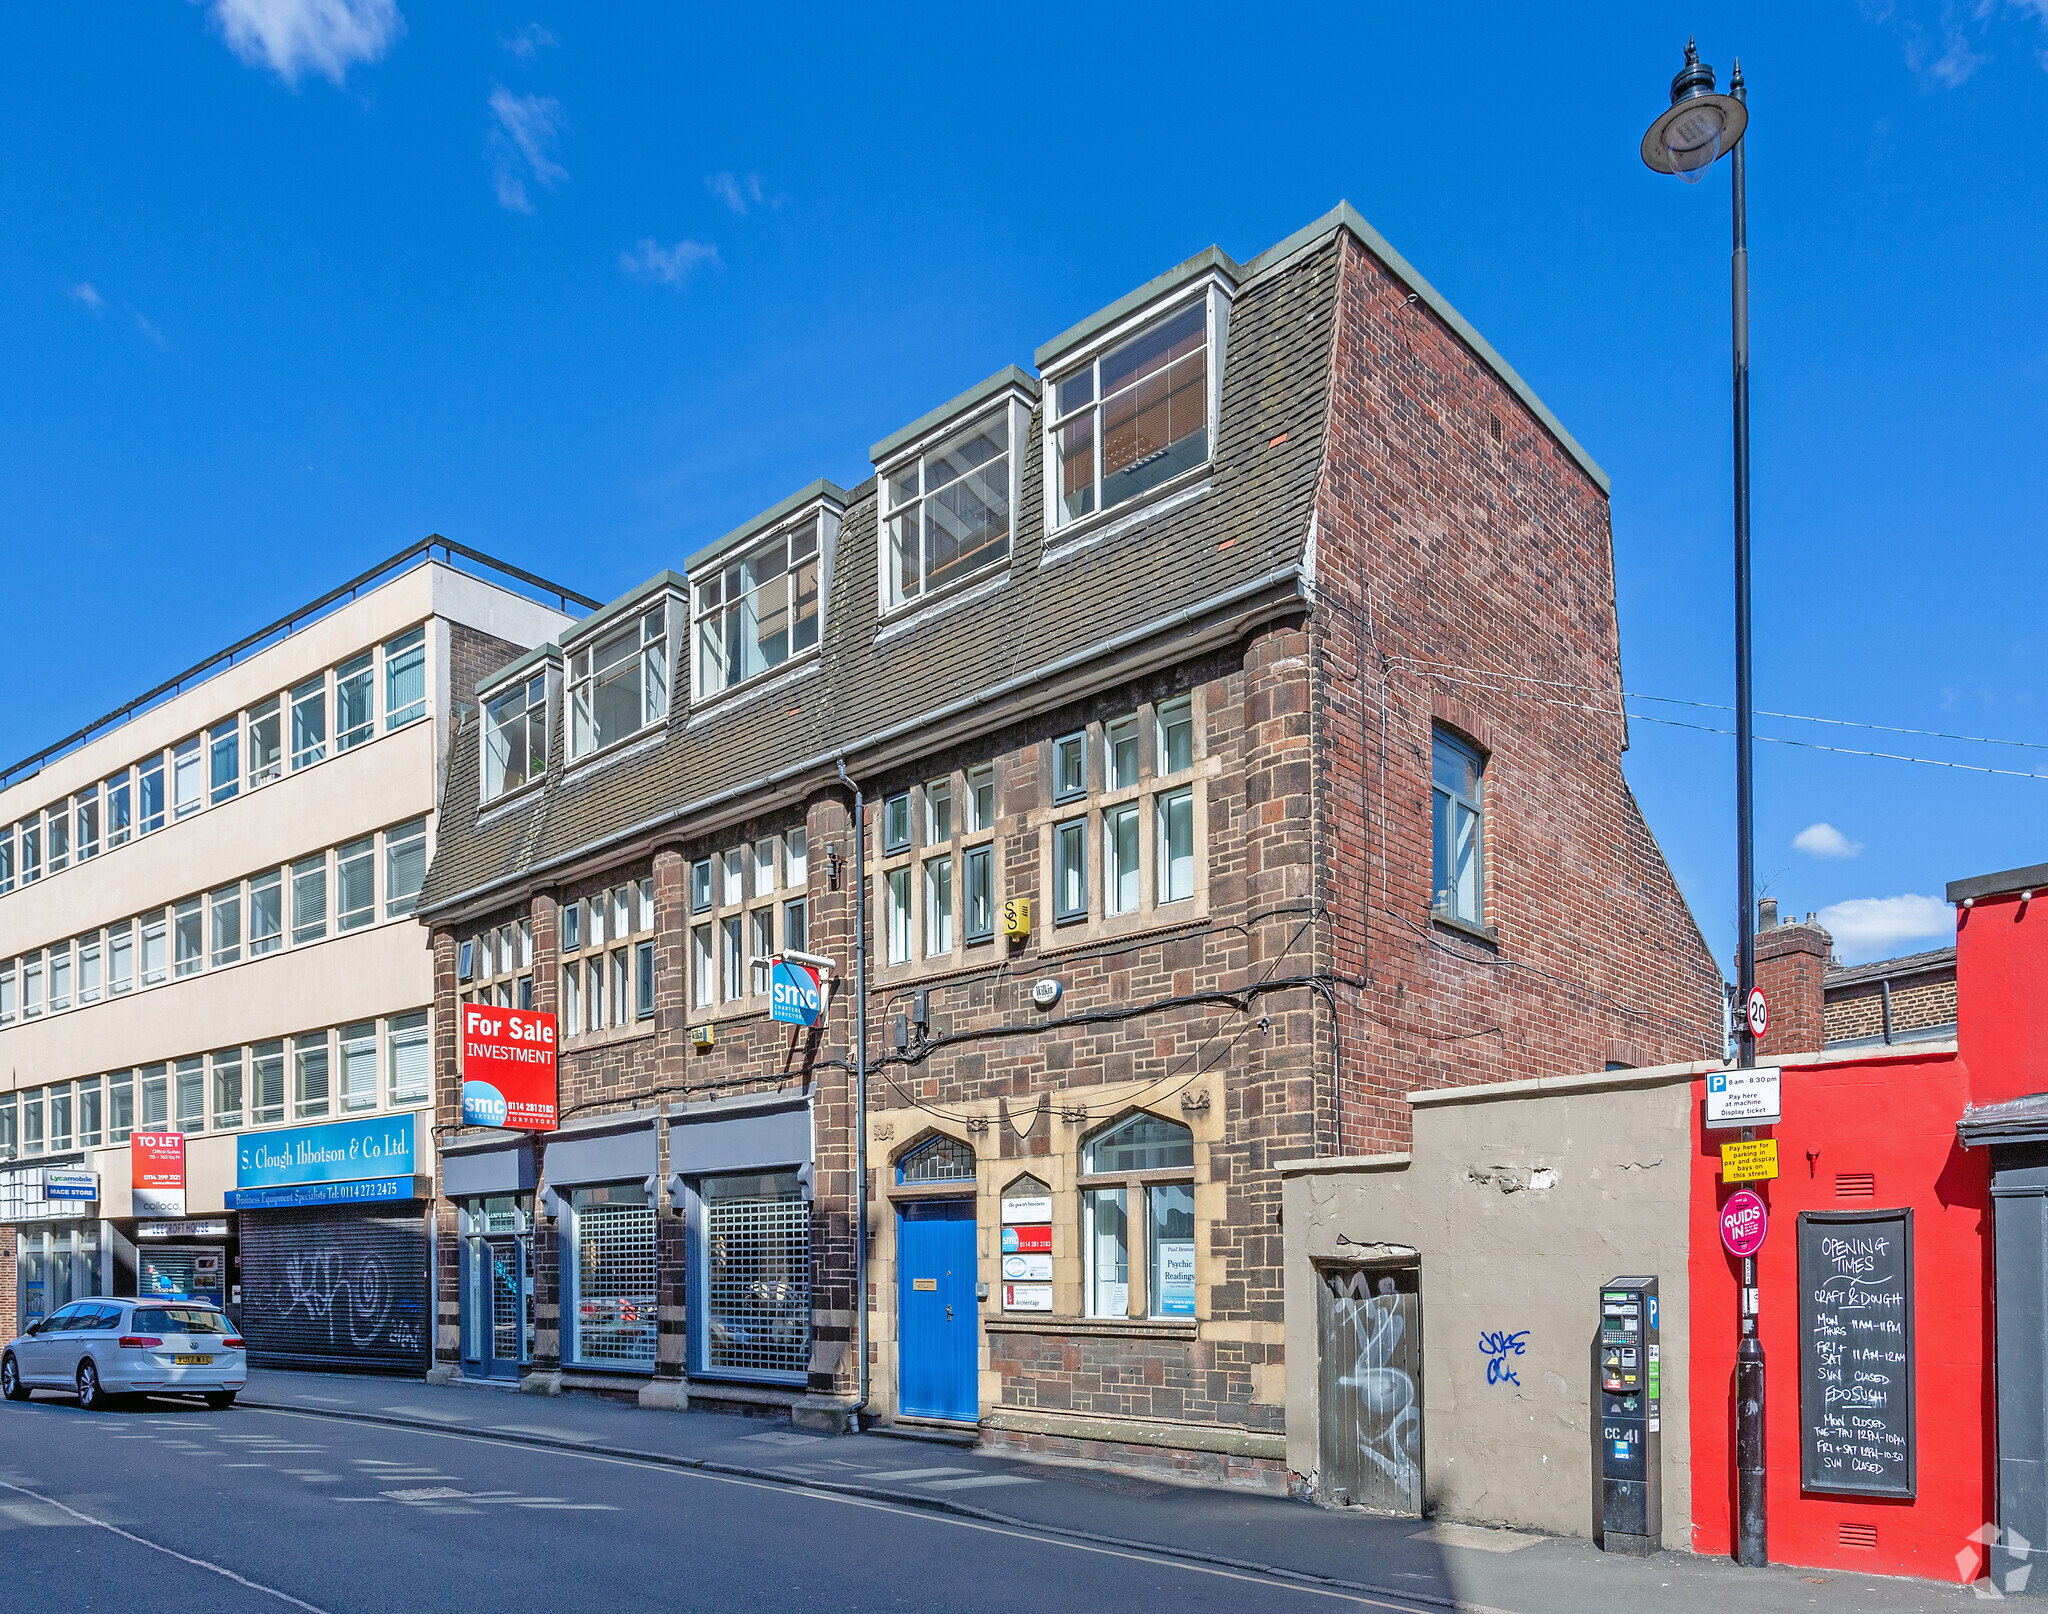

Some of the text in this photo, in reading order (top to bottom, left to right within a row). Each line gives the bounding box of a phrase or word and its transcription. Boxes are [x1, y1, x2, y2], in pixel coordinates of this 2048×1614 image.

[774, 983, 817, 1009] smc
[1752, 1001, 1766, 1024] 20
[467, 1012, 553, 1043] For Sale
[467, 1042, 553, 1064] INVESTMENT
[1713, 1077, 1724, 1091] P
[465, 1097, 504, 1114] smc
[508, 1101, 524, 1111] 0114
[526, 1103, 537, 1112] 281
[465, 1113, 556, 1125] CHARTERED SURVEYORS
[138, 1136, 180, 1147] TO LET
[242, 1129, 409, 1171] S. Clough Ibbotson & Co Ltd.
[236, 1182, 397, 1205] Business Equipment Specialists Tel: 0114 272 2475
[1725, 1206, 1760, 1228] QUIDS
[153, 1222, 209, 1234] LEECROFT HOUSE
[1732, 1224, 1744, 1240] IN
[1003, 1236, 1018, 1245] smc
[1822, 1237, 1890, 1256] OPENING
[1167, 1260, 1192, 1269] Psychic
[1832, 1255, 1874, 1273] TIMES
[1165, 1272, 1195, 1281] Readings
[1815, 1287, 1904, 1307] CRAFT & DOUGH
[1817, 1313, 1838, 1326] MON
[1479, 1331, 1530, 1358] JOKE
[1816, 1341, 1836, 1354] FRI
[1821, 1353, 1841, 1365] SAT
[1818, 1368, 1890, 1384] SUN CLOSED
[1824, 1413, 1886, 1430] MON CLOSED
[1605, 1427, 1638, 1444] CC 41
[1817, 1440, 1833, 1453] FRI
[1824, 1457, 1884, 1474] SUN CLOSED
